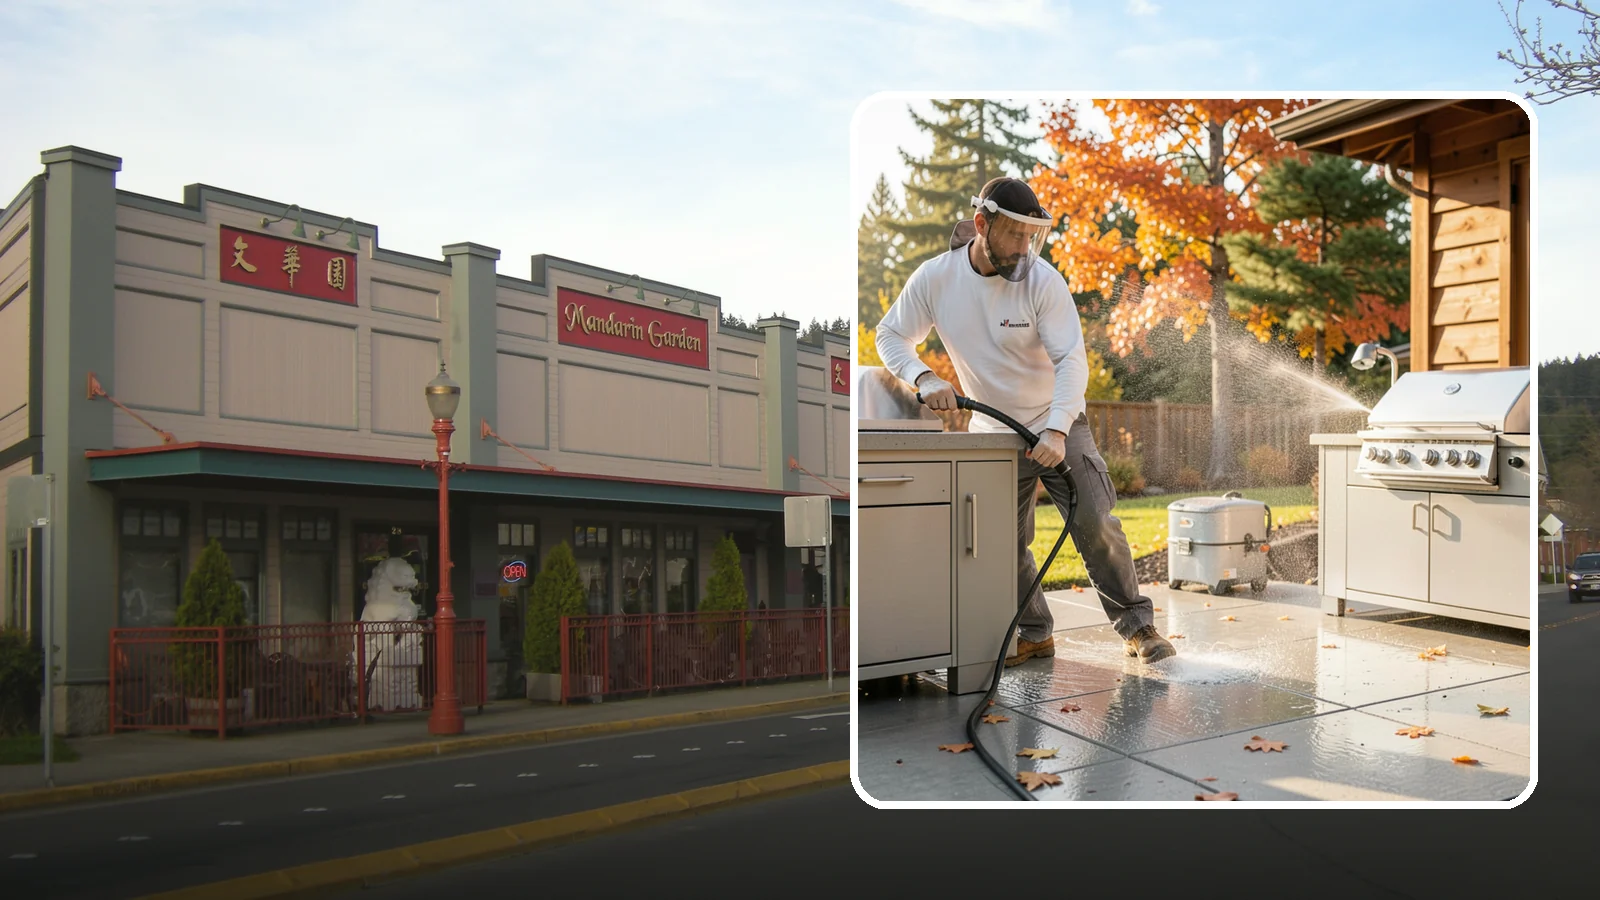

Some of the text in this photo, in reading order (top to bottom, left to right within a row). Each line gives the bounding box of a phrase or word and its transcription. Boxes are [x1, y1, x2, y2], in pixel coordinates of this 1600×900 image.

[230, 235, 346, 291] 文華園
[564, 302, 701, 352] Mandarin Garden
[503, 565, 527, 578] OPEN
